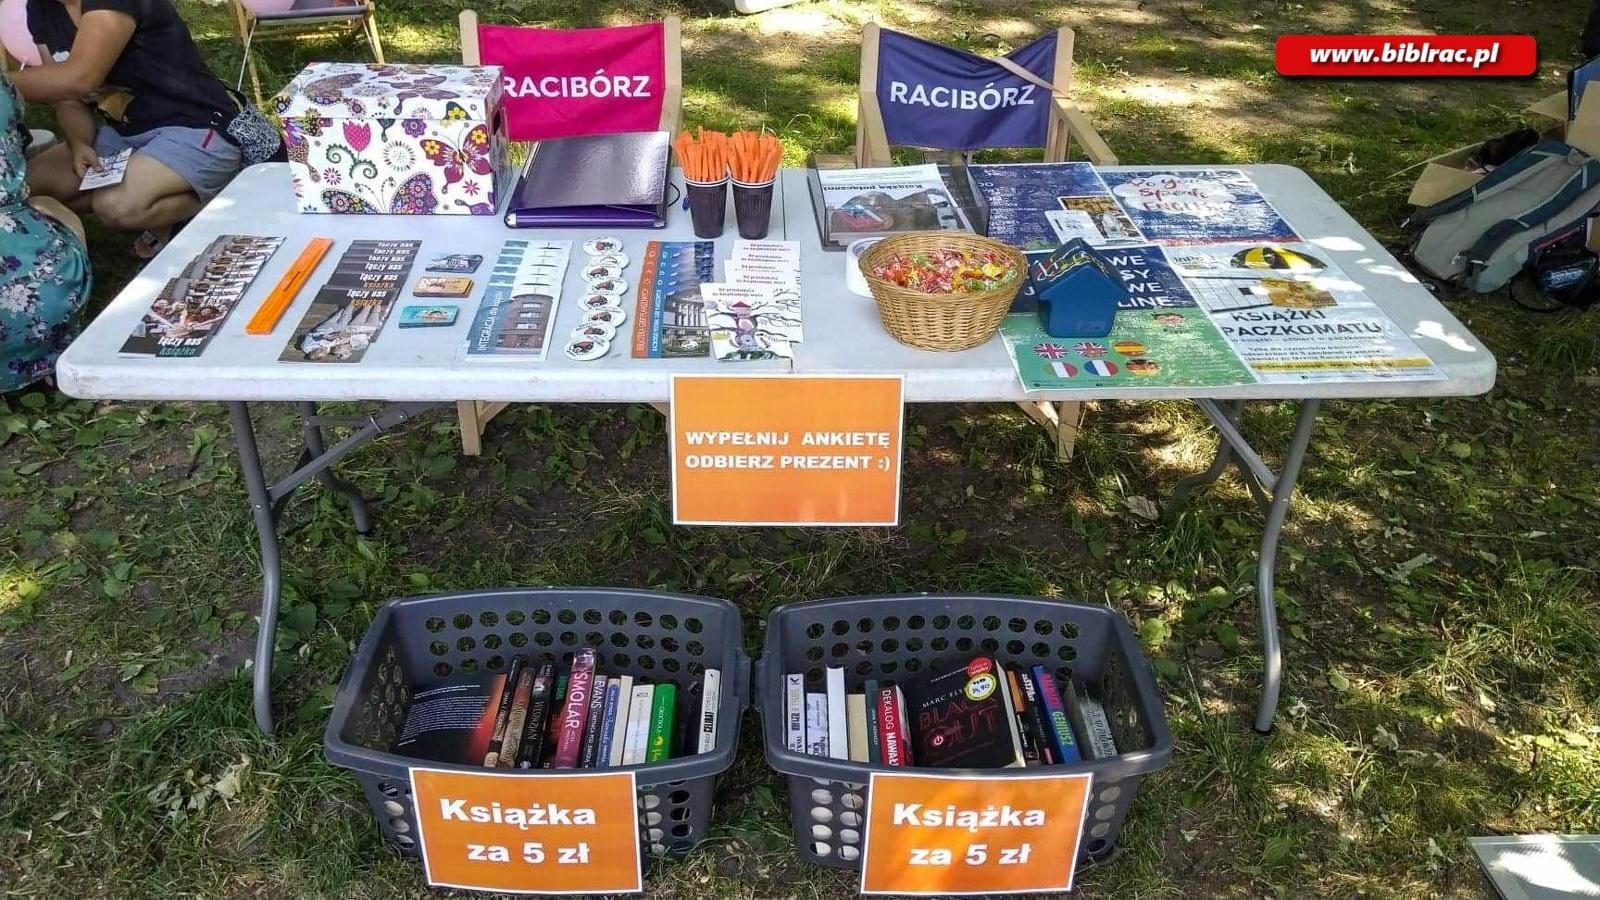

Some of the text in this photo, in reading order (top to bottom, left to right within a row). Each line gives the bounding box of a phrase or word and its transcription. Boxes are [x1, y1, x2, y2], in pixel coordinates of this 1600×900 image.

[503, 69, 651, 98] RACIBÓRZ
[890, 82, 1036, 110] RACIBÓRZ
[1231, 308, 1327, 322] KSIĄŻKI
[1220, 322, 1383, 337] PACZKOMATU
[685, 431, 891, 448] WYPEŁNIJ ANKIETĘ
[685, 455, 891, 472] ODBIERZ PREZENT :)
[564, 673, 589, 729] SMOLAR
[591, 680, 606, 709] EVANS
[922, 694, 946, 709] MARC
[882, 689, 895, 730] DEKALOG
[1052, 711, 1074, 746] GENIUSZ
[440, 798, 596, 830] Książka
[893, 803, 1046, 833] Książka
[467, 842, 590, 864] za 5 zł
[909, 843, 1032, 865] za 5 zł
